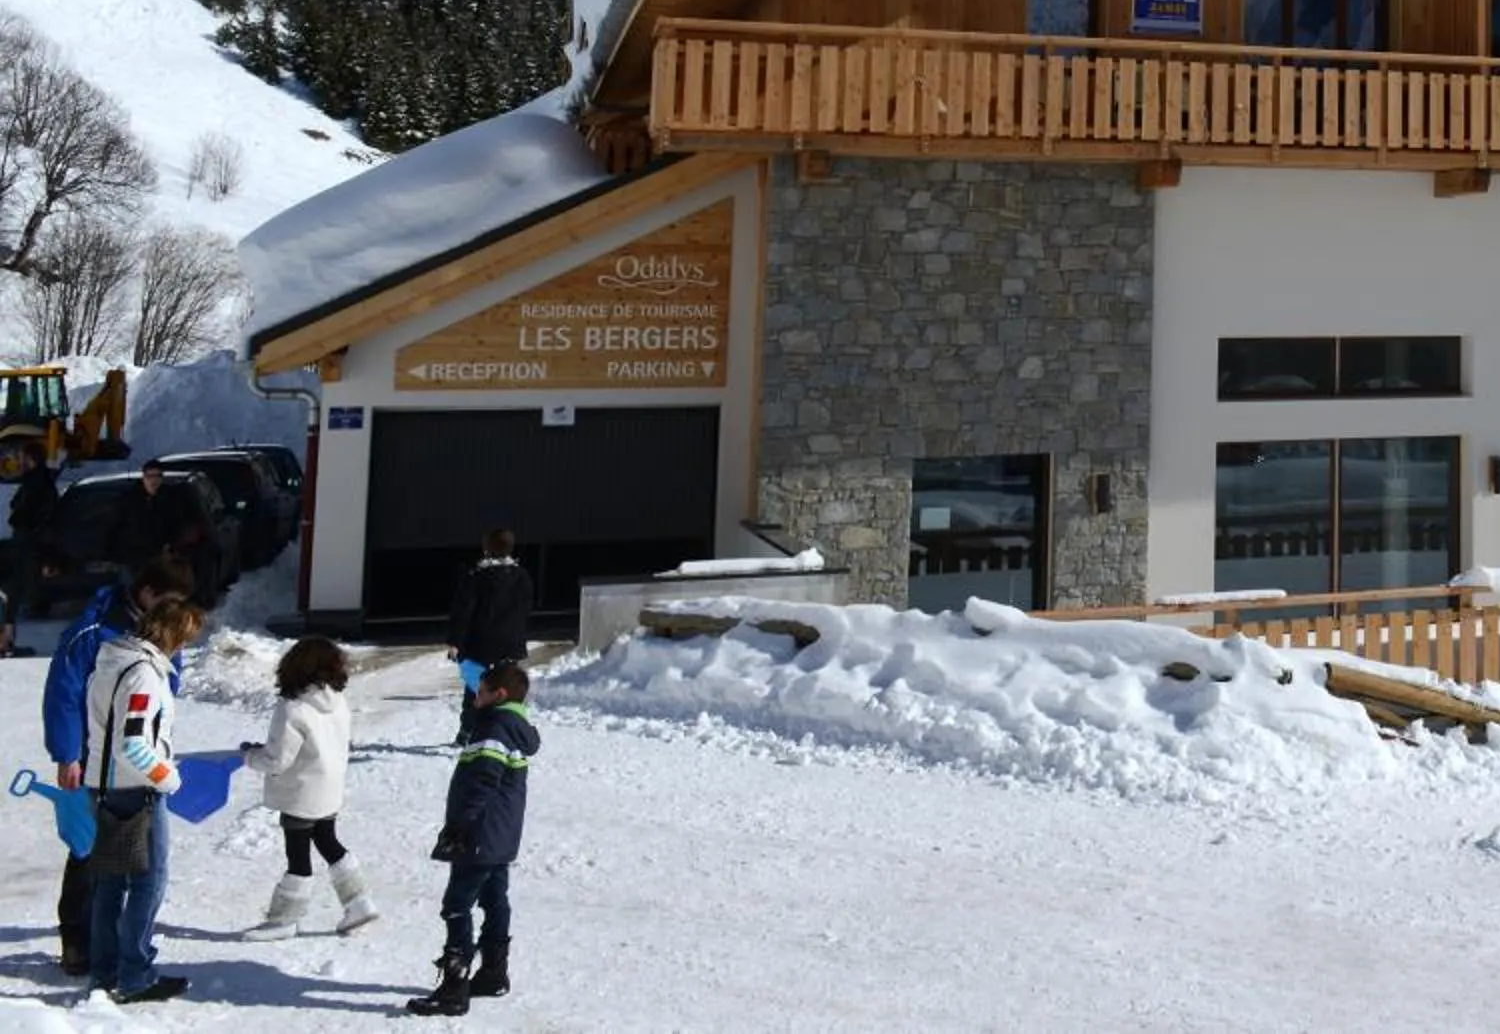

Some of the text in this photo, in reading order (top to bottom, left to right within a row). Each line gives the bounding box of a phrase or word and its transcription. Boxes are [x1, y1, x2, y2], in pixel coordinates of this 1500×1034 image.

[612, 253, 708, 286] Odalys
[613, 303, 633, 318] DE
[640, 303, 718, 318] TOURISME
[519, 326, 718, 351] LES BERGERS
[430, 361, 547, 379] RECEPTION
[607, 361, 695, 378] PARKING
